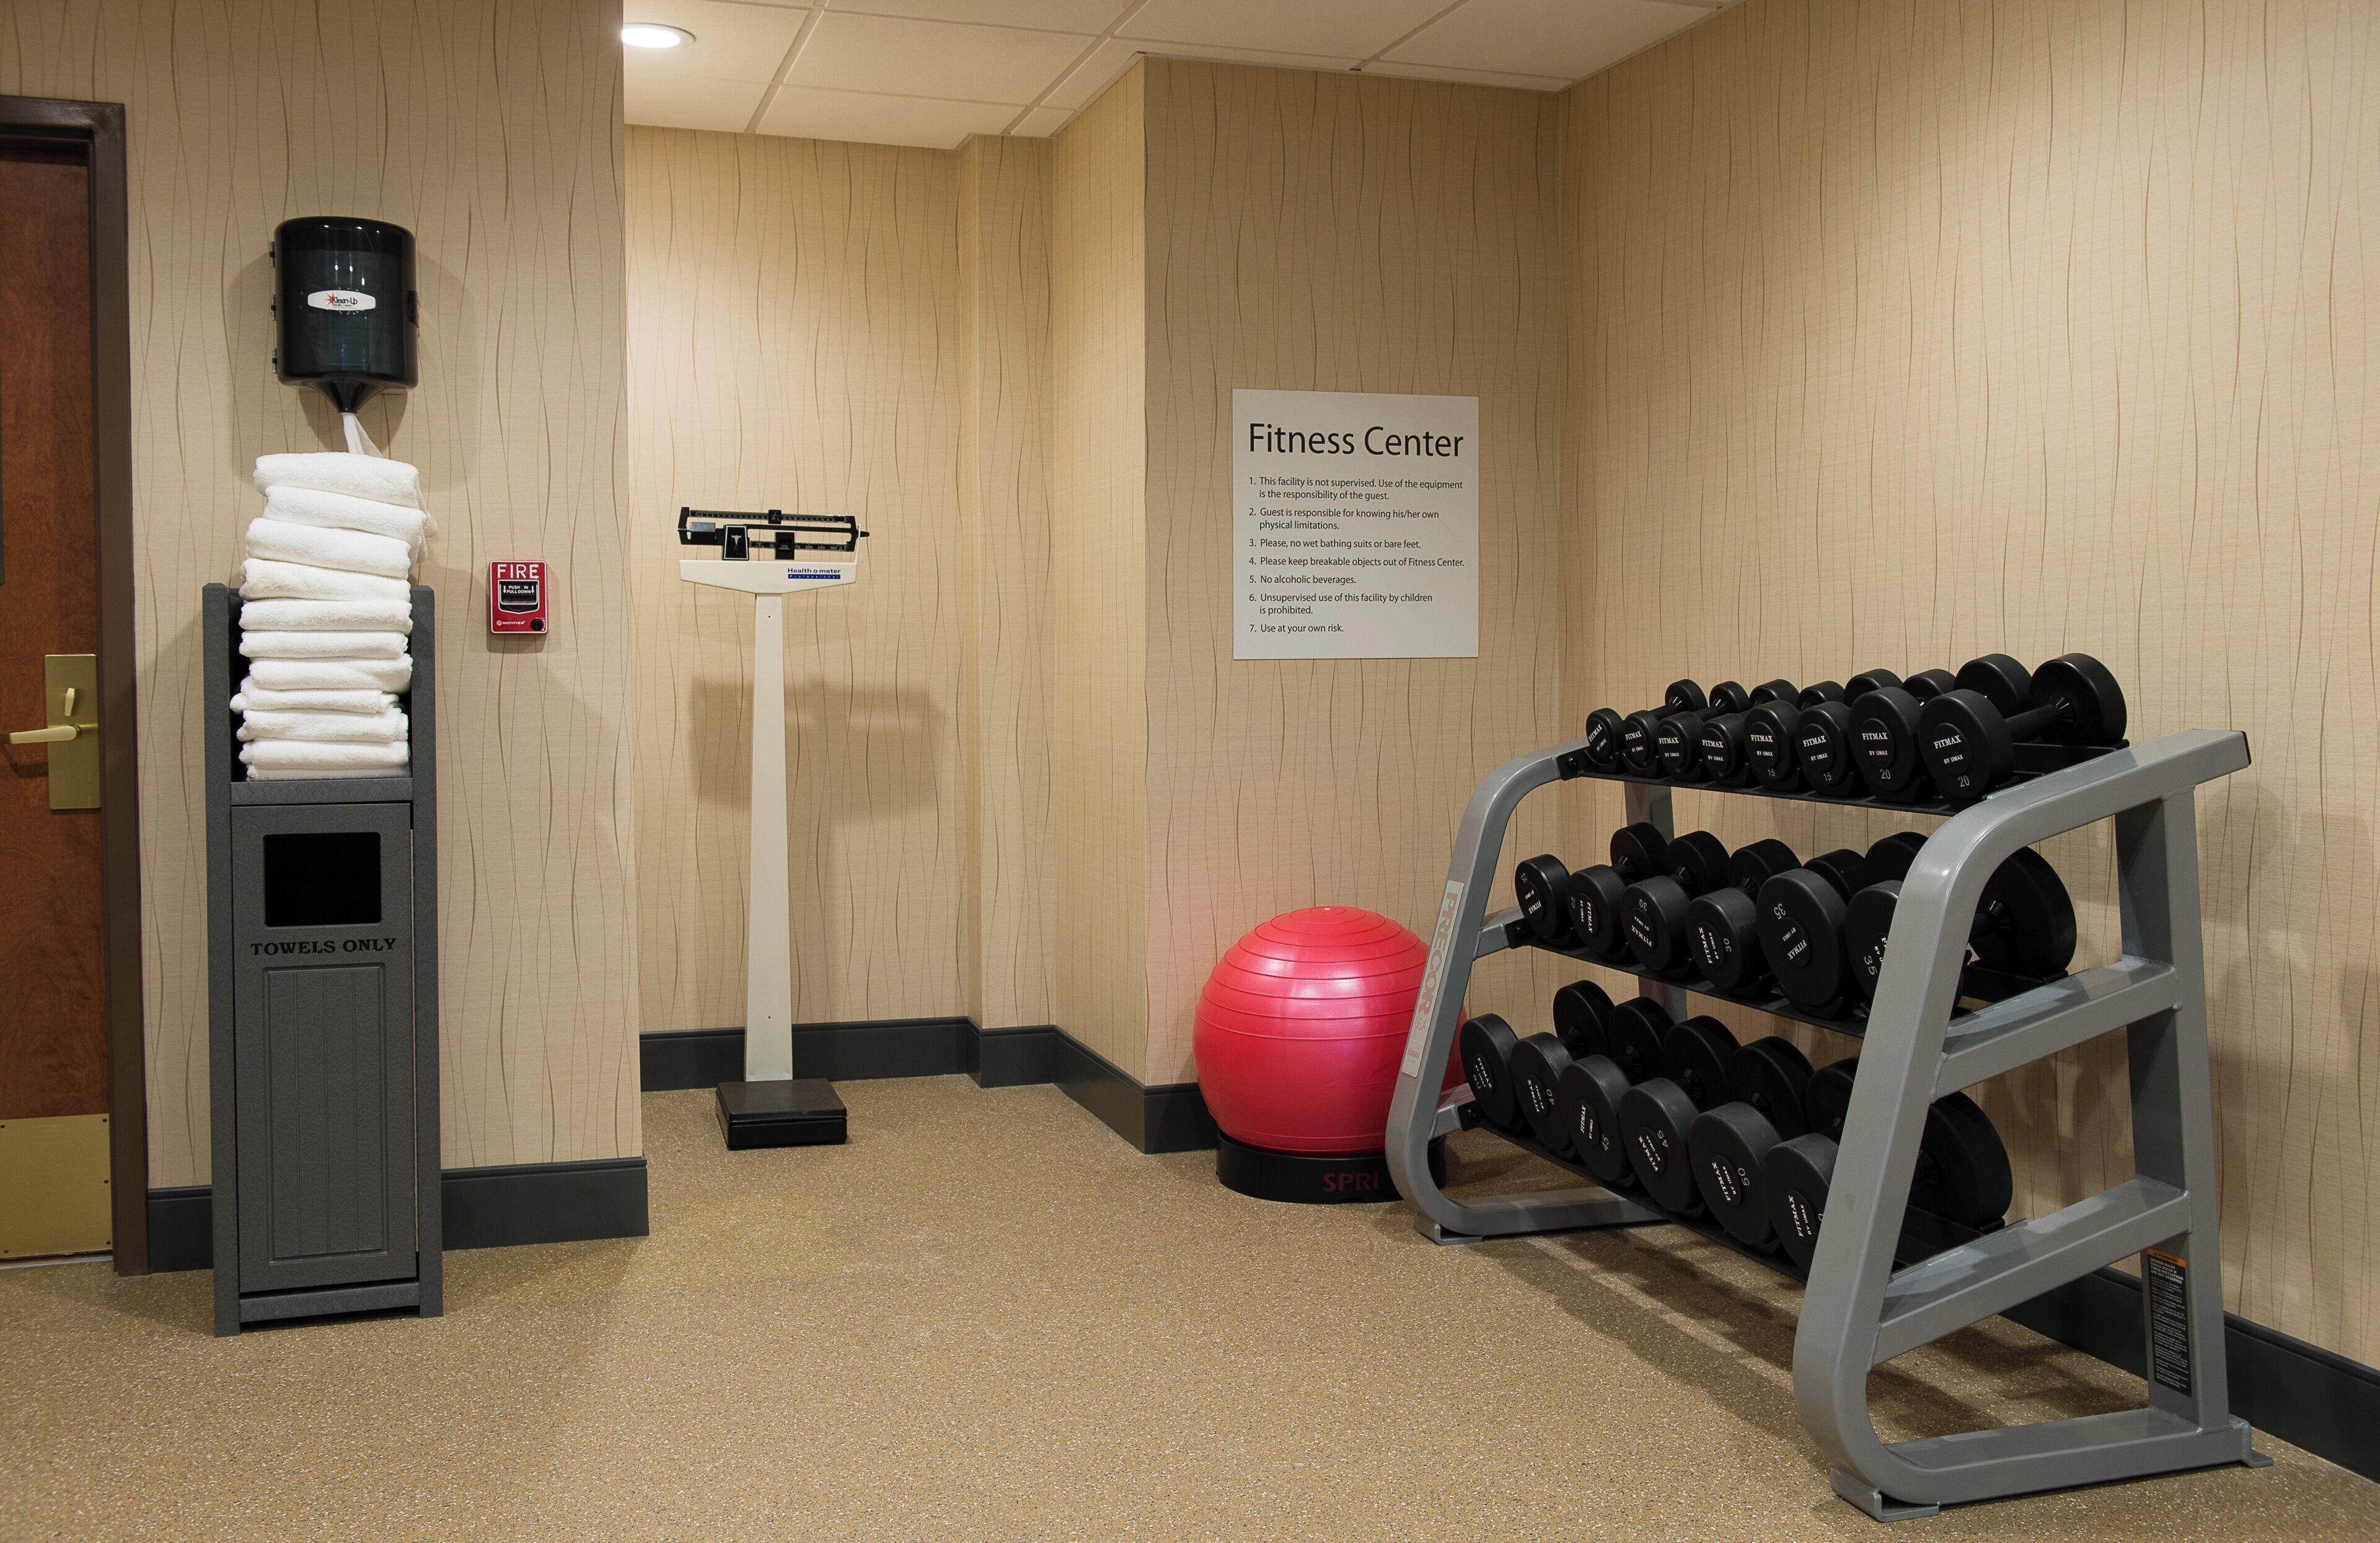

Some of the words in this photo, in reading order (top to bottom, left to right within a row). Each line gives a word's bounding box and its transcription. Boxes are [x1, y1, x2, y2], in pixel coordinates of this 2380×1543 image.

[1250, 423, 1354, 454] Fitness
[1365, 426, 1463, 457] Center
[1259, 477, 1276, 485] This
[1278, 477, 1305, 488] facility
[1307, 478, 1313, 486] is
[1331, 479, 1377, 488] supervised.
[1420, 481, 1463, 490] equipment
[1259, 490, 1266, 498] is
[1267, 490, 1281, 498] the
[1284, 490, 1338, 501] responsibility
[1340, 491, 1348, 499] of
[1350, 491, 1363, 499] the
[1365, 493, 1389, 501] guest.
[1261, 508, 1284, 516] Guest
[1287, 508, 1292, 516] is
[1295, 509, 1341, 518] responsible
[1343, 509, 1354, 517] for
[1357, 509, 1391, 520] knowing
[1393, 509, 1420, 518] his/her
[1259, 521, 1292, 530] physical
[1295, 521, 1339, 529] limitations.
[1261, 539, 1288, 548] Please,
[1321, 539, 1352, 550] bathing
[1354, 540, 1372, 548] suits
[1385, 540, 1402, 548] bare
[1404, 540, 1421, 548] feet.
[1250, 557, 1256, 565] 4.
[1261, 556, 1286, 565] Please
[1289, 556, 1308, 567] keep
[1311, 557, 1351, 566] breakable
[1352, 558, 1381, 568] objects
[1399, 558, 1407, 566] of
[1437, 558, 1464, 566] Center.
[497, 564, 539, 579] FIRE
[1261, 575, 1272, 583] No
[1274, 575, 1311, 583] alcoholic
[1313, 575, 1356, 586] beverages.
[1250, 594, 1256, 602] 6.
[1261, 593, 1316, 604] Unsupervised
[1334, 593, 1343, 602] of
[1345, 594, 1359, 602] this
[1361, 593, 1387, 604] facility
[1390, 594, 1399, 604] by
[1401, 594, 1432, 602] children
[1260, 606, 1266, 614] is
[1268, 606, 1313, 616] prohibited.
[1288, 626, 1307, 634] your
[1328, 623, 1344, 632] risk.
[1589, 724, 1603, 742] FITMAX
[1625, 731, 1642, 740] FITMAX
[1803, 736, 1826, 747] FITMAX
[1934, 735, 1962, 749] FITMAX
[1768, 768, 1775, 777] 15
[1823, 772, 1832, 781] 15
[1880, 769, 1890, 780] 20
[1958, 775, 1970, 787] 20
[1639, 899, 1647, 911] 30
[1774, 903, 1786, 920] 35
[1631, 925, 1652, 947] FITMAX
[250, 940, 336, 957] TOWELS
[342, 938, 397, 953] ONLY
[1698, 927, 1712, 964] FITMAX
[1723, 938, 1732, 952] 30
[1787, 939, 1807, 960] FITMAX
[1418, 892, 1458, 1016] PRECOR
[1864, 956, 1878, 975] 35
[1415, 1016, 1426, 1031] USA
[1657, 1130, 1668, 1148] 45
[1639, 1135, 1659, 1172] FITMAX
[1322, 1172, 1378, 1192] SPRI
[1712, 1162, 1731, 1201] FITMAX
[1738, 1167, 1750, 1186] 50
[1788, 1195, 1804, 1237] FITMAX
